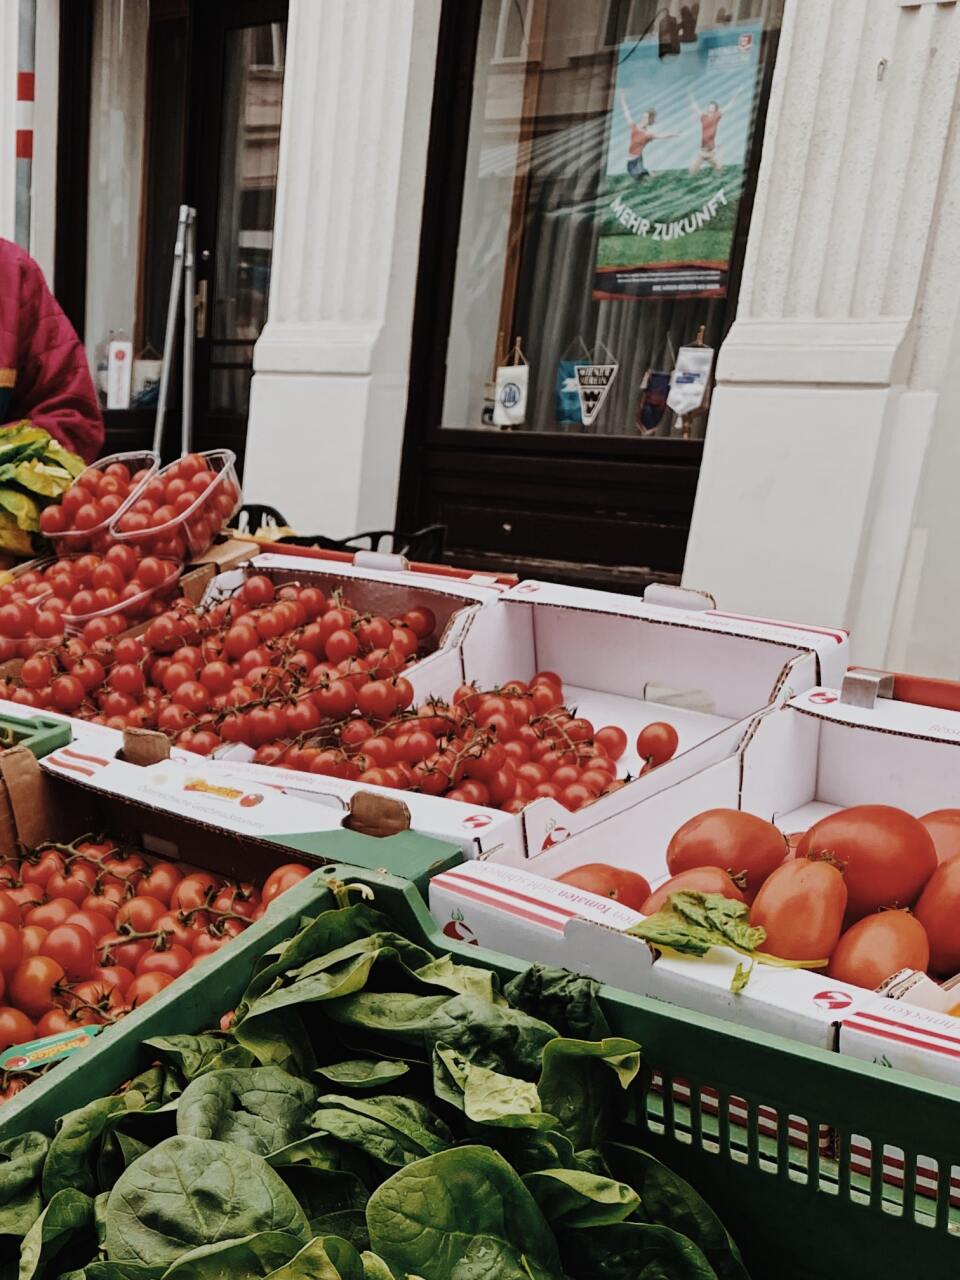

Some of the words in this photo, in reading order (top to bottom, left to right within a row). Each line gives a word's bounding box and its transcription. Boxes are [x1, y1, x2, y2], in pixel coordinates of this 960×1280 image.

[610, 197, 651, 237] MEHR
[651, 188, 728, 241] ZUKUNFT
[557, 890, 613, 916] Tomaten
